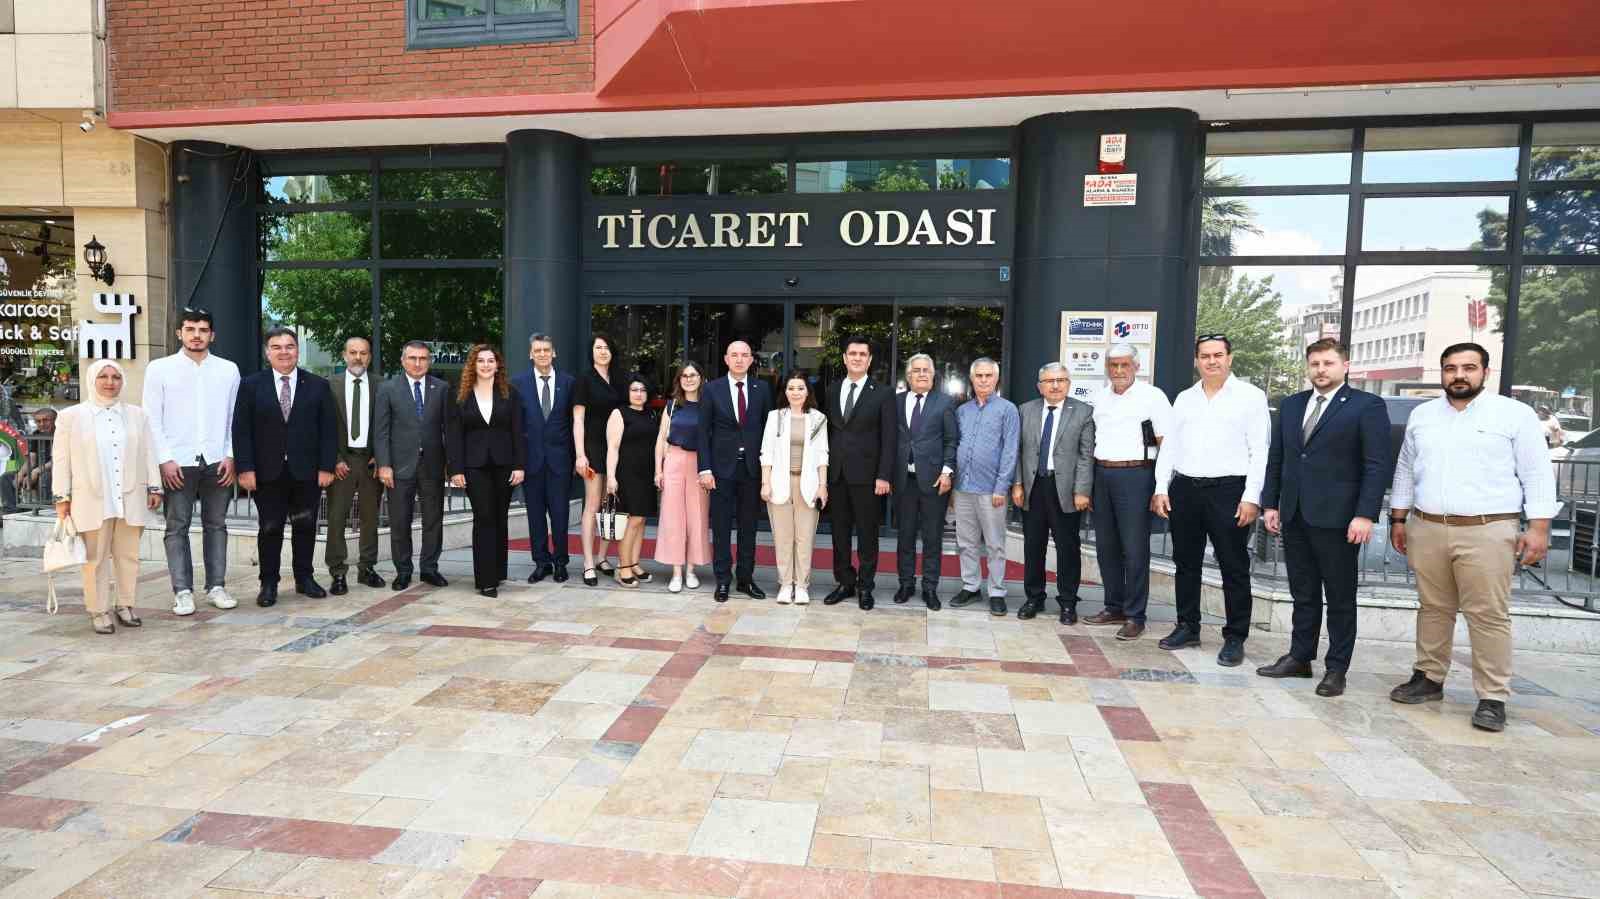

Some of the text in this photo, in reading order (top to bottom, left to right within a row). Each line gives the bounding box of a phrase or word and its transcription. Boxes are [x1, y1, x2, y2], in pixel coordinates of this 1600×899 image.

[597, 208, 997, 249] TİCARET ODASI
[30, 325, 42, 340] &
